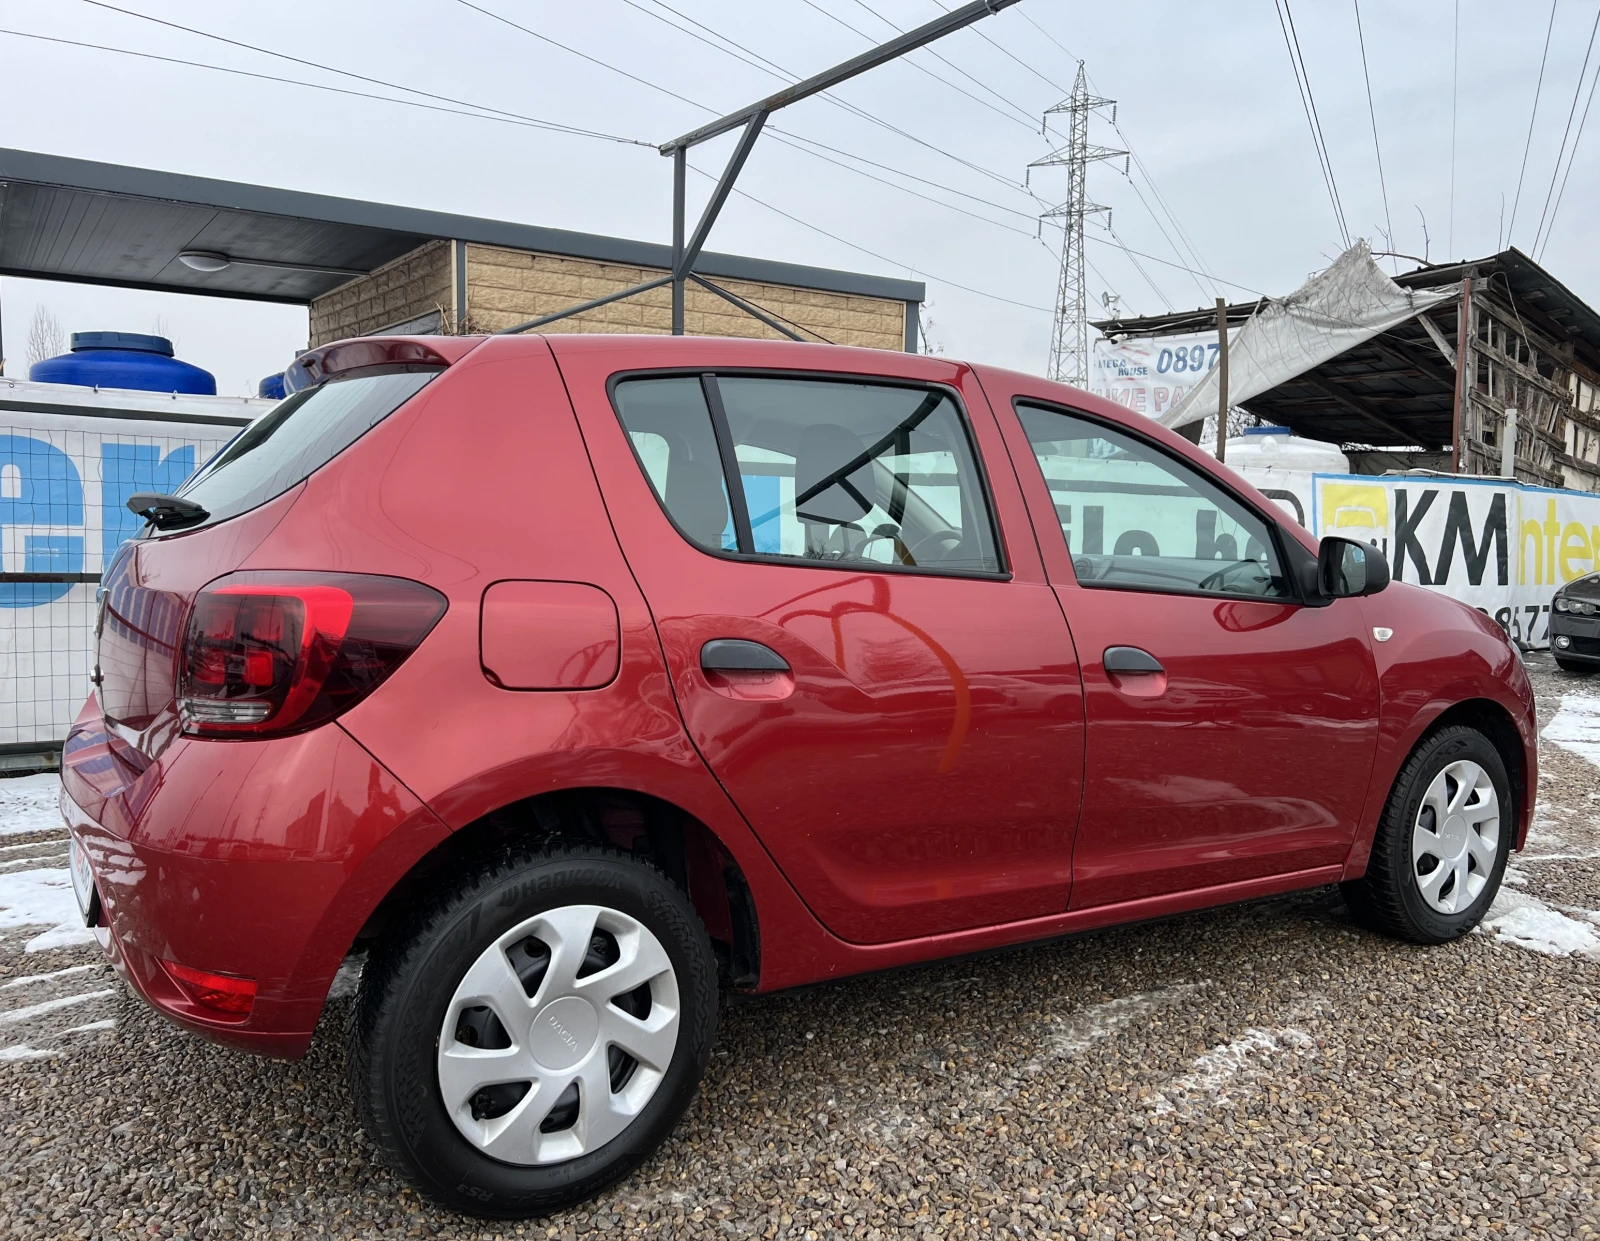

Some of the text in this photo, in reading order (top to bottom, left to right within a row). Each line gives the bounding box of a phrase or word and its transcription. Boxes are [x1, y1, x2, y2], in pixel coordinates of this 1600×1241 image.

[1118, 367, 1148, 376] HOUSE
[1156, 343, 1220, 374] 0897
[1392, 488, 1508, 586] KM
[1401, 798, 1417, 865] KUMHO
[548, 1015, 579, 1052] DACIA
[457, 1183, 495, 1202] RS3
